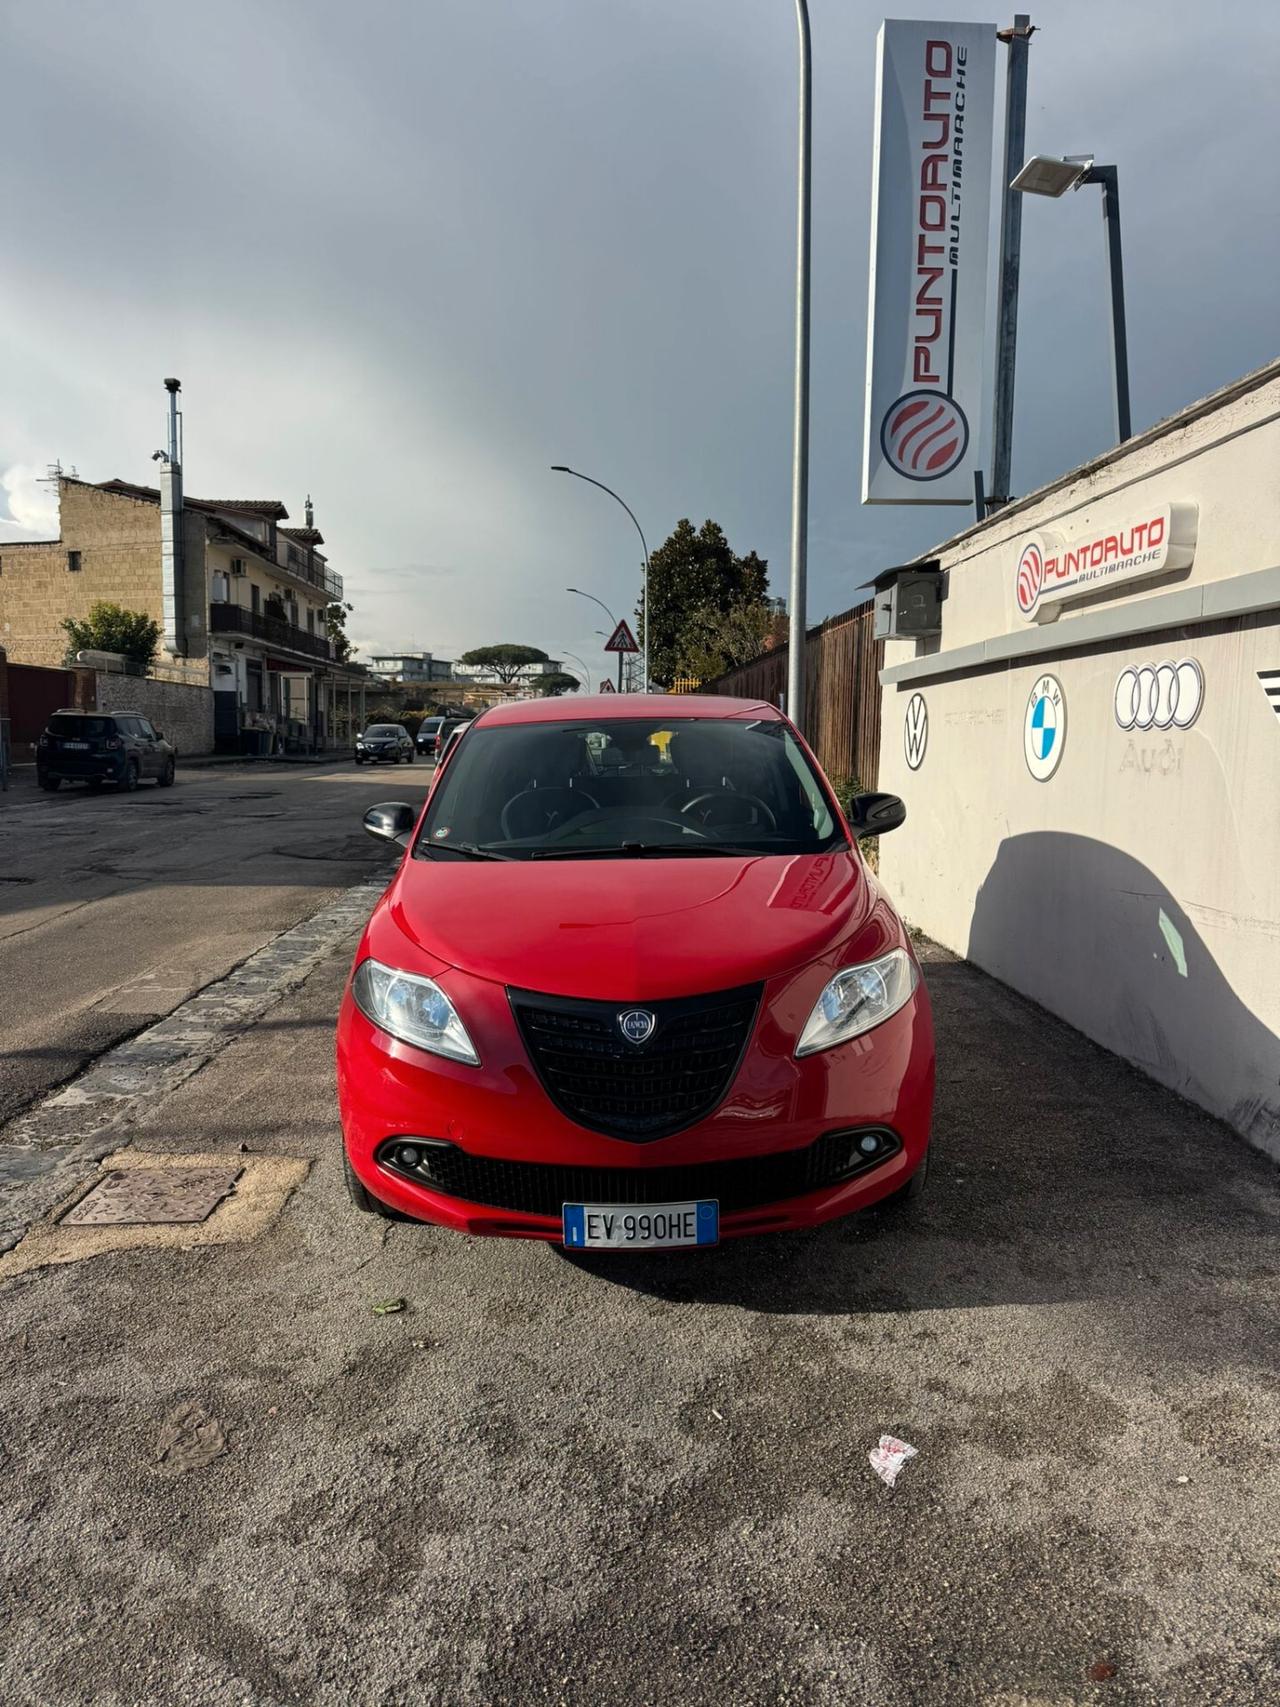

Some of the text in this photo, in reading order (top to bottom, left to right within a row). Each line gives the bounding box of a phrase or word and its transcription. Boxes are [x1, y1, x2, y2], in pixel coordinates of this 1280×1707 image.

[949, 46, 967, 266] MULTIMARCHE
[913, 40, 953, 382] PUNTOAUTO
[1044, 517, 1164, 583] PUNTOAUTO
[1078, 549, 1161, 583] MULTIMARCHE
[587, 1212, 696, 1240] EV 990HE
